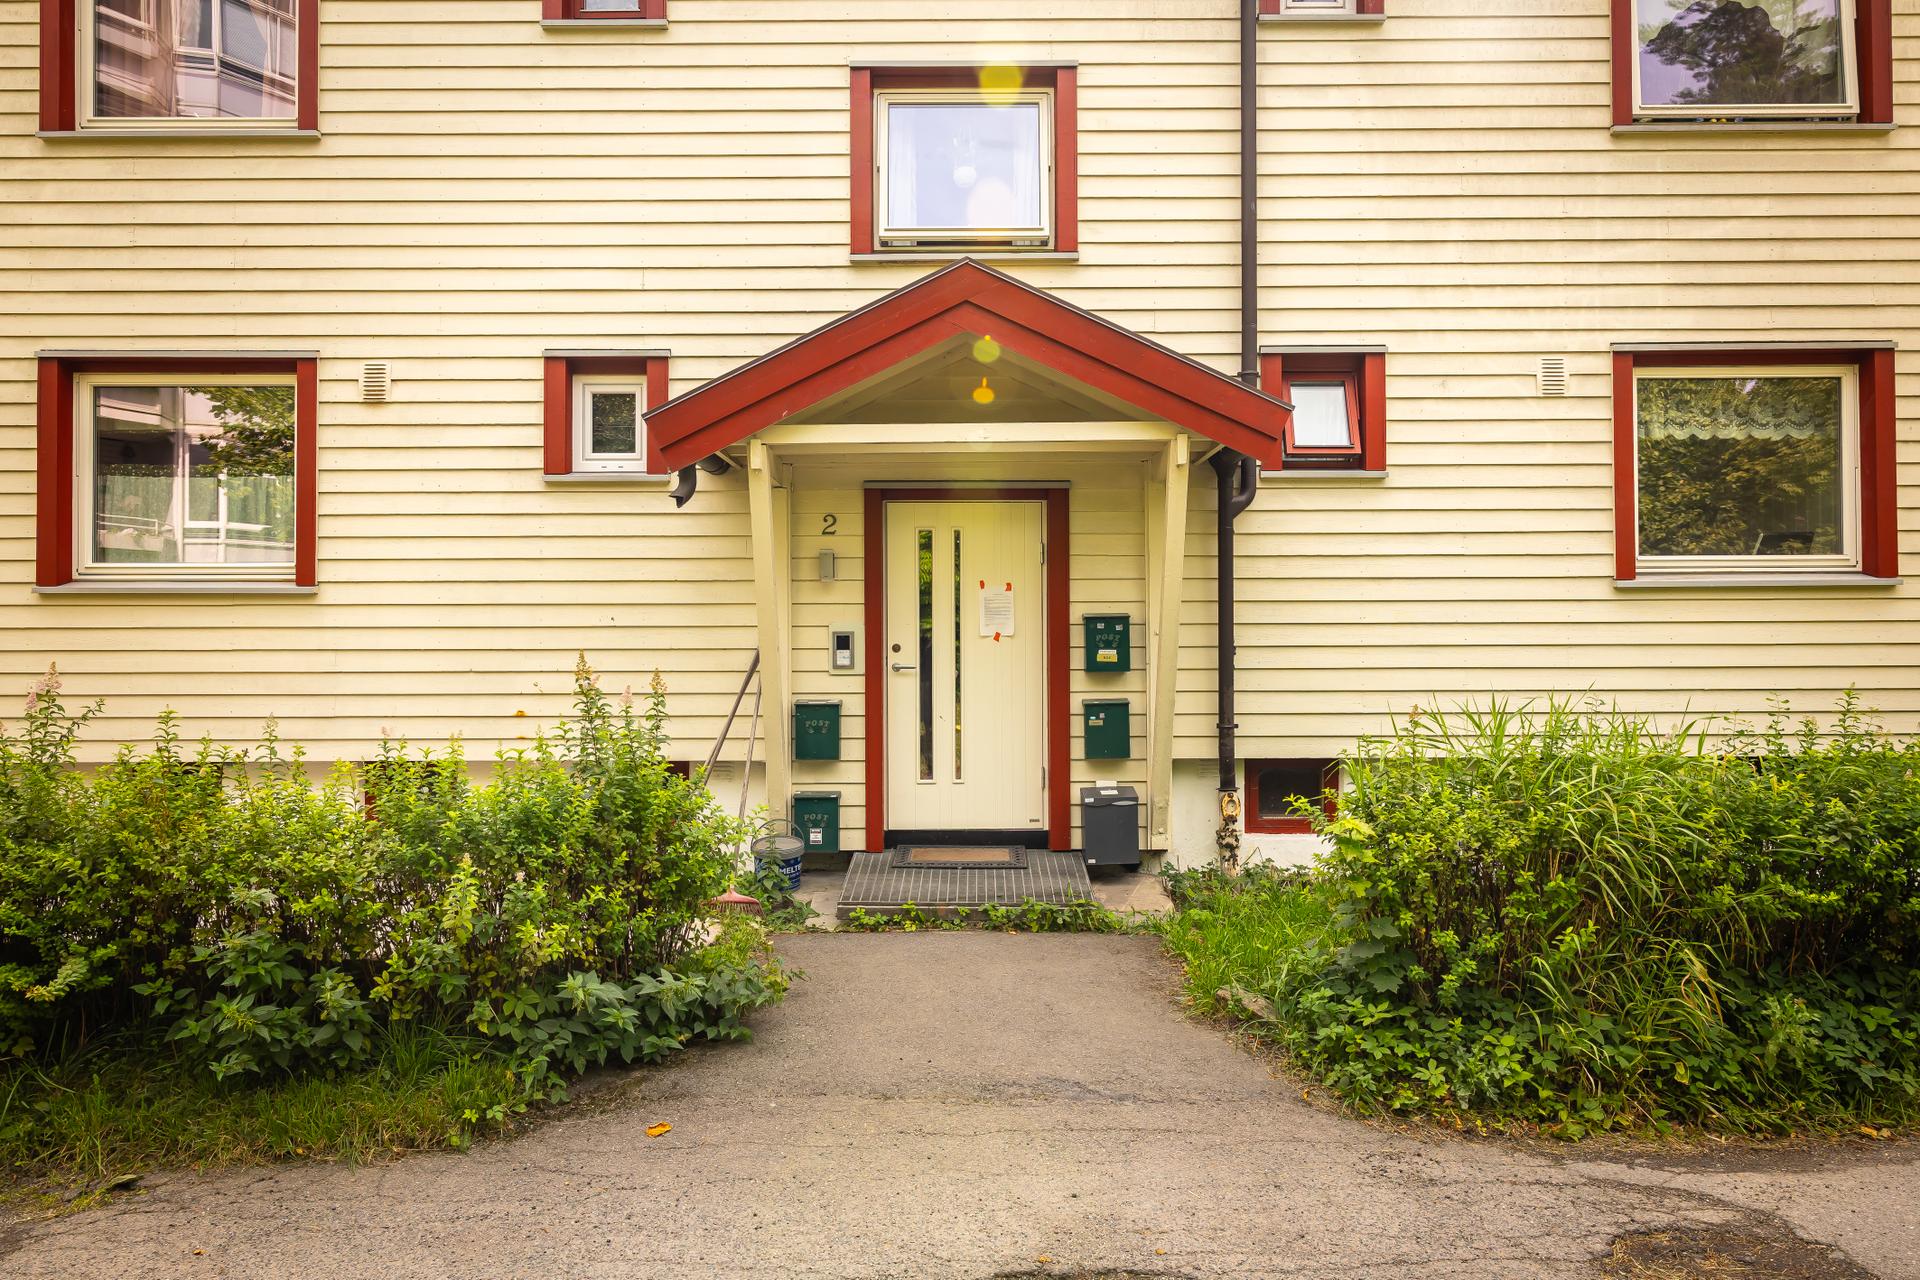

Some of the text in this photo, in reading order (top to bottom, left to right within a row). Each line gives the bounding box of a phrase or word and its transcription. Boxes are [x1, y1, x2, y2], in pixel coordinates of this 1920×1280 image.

[822, 514, 837, 535] 2
[1096, 633, 1120, 641] POST
[805, 719, 830, 728] POST
[803, 813, 829, 821] POST
